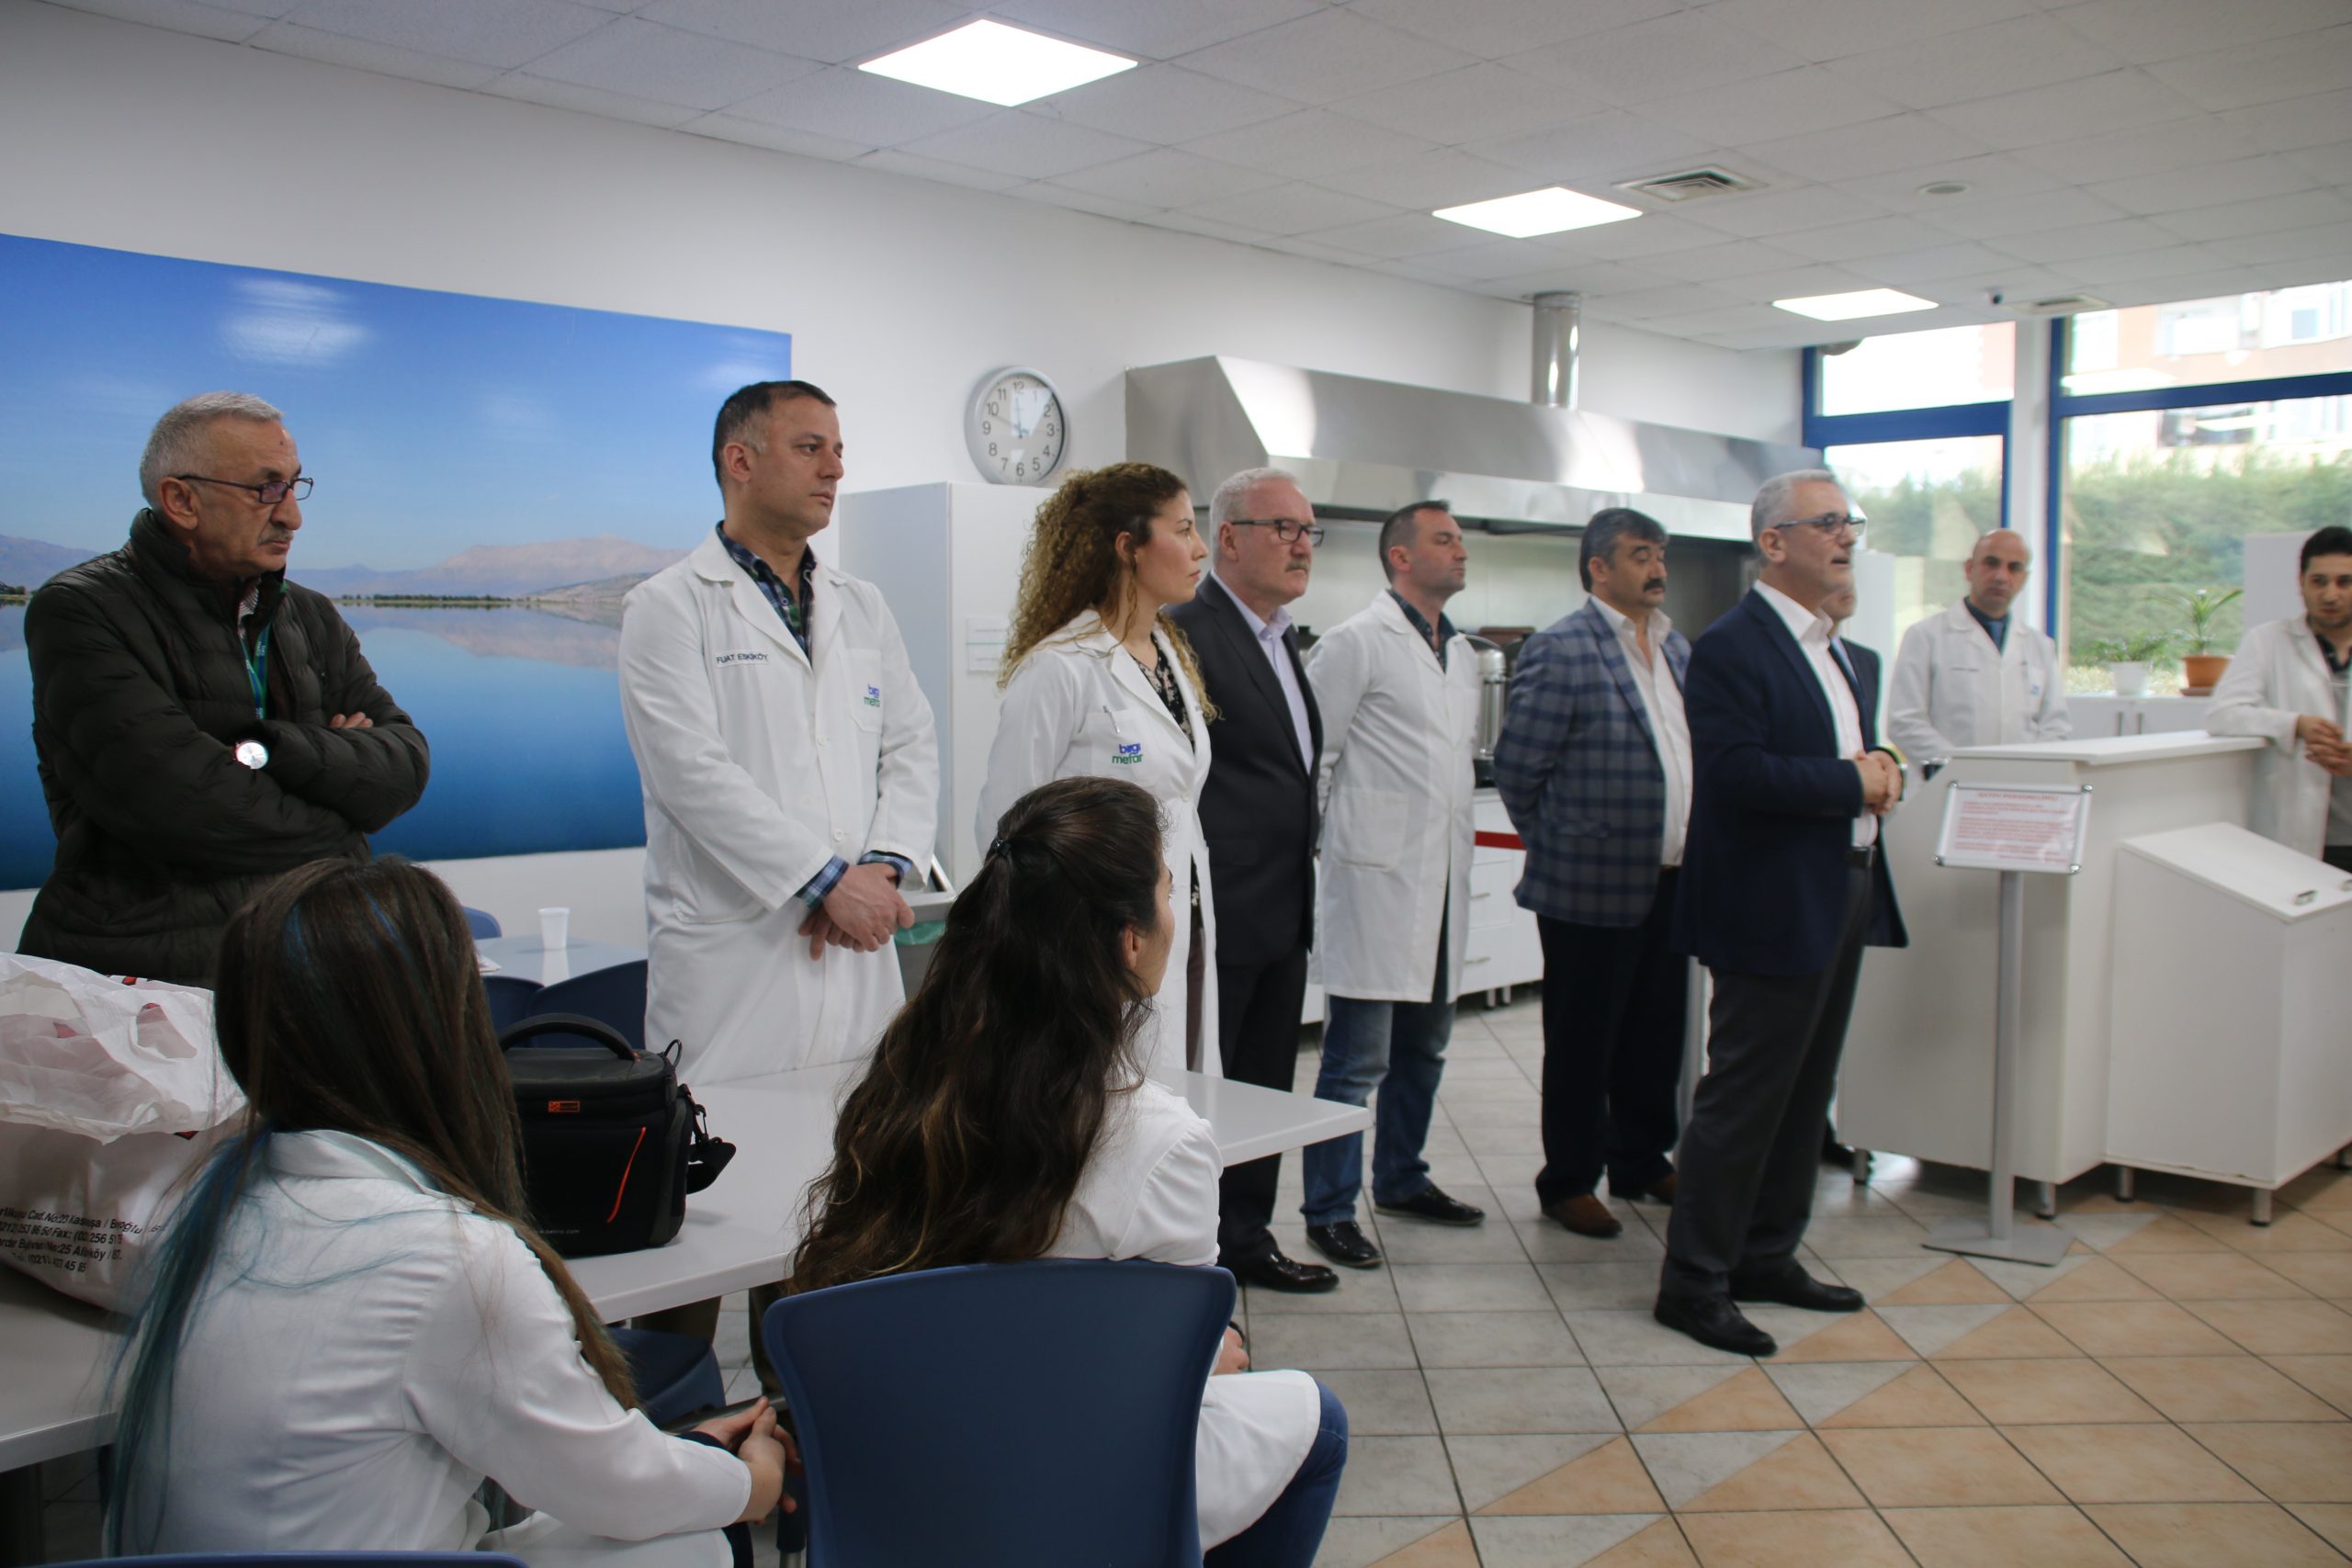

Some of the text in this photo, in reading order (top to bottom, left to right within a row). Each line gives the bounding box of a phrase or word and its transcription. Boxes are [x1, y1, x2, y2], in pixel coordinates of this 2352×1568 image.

[998, 389, 1007, 400] 11
[1012, 381, 1024, 394] 12
[987, 401, 1000, 416] 10
[1043, 403, 1052, 418] 2
[981, 421, 991, 435] 9
[1046, 423, 1056, 437] 3
[988, 442, 998, 457] 8
[1042, 445, 1050, 457] 4
[1001, 457, 1009, 471] 7
[1015, 462, 1025, 477] 6
[1032, 457, 1041, 471] 5
[717, 654, 735, 663] FUAT
[1112, 753, 1144, 764] mefar
[88, 1233, 107, 1244] 256
